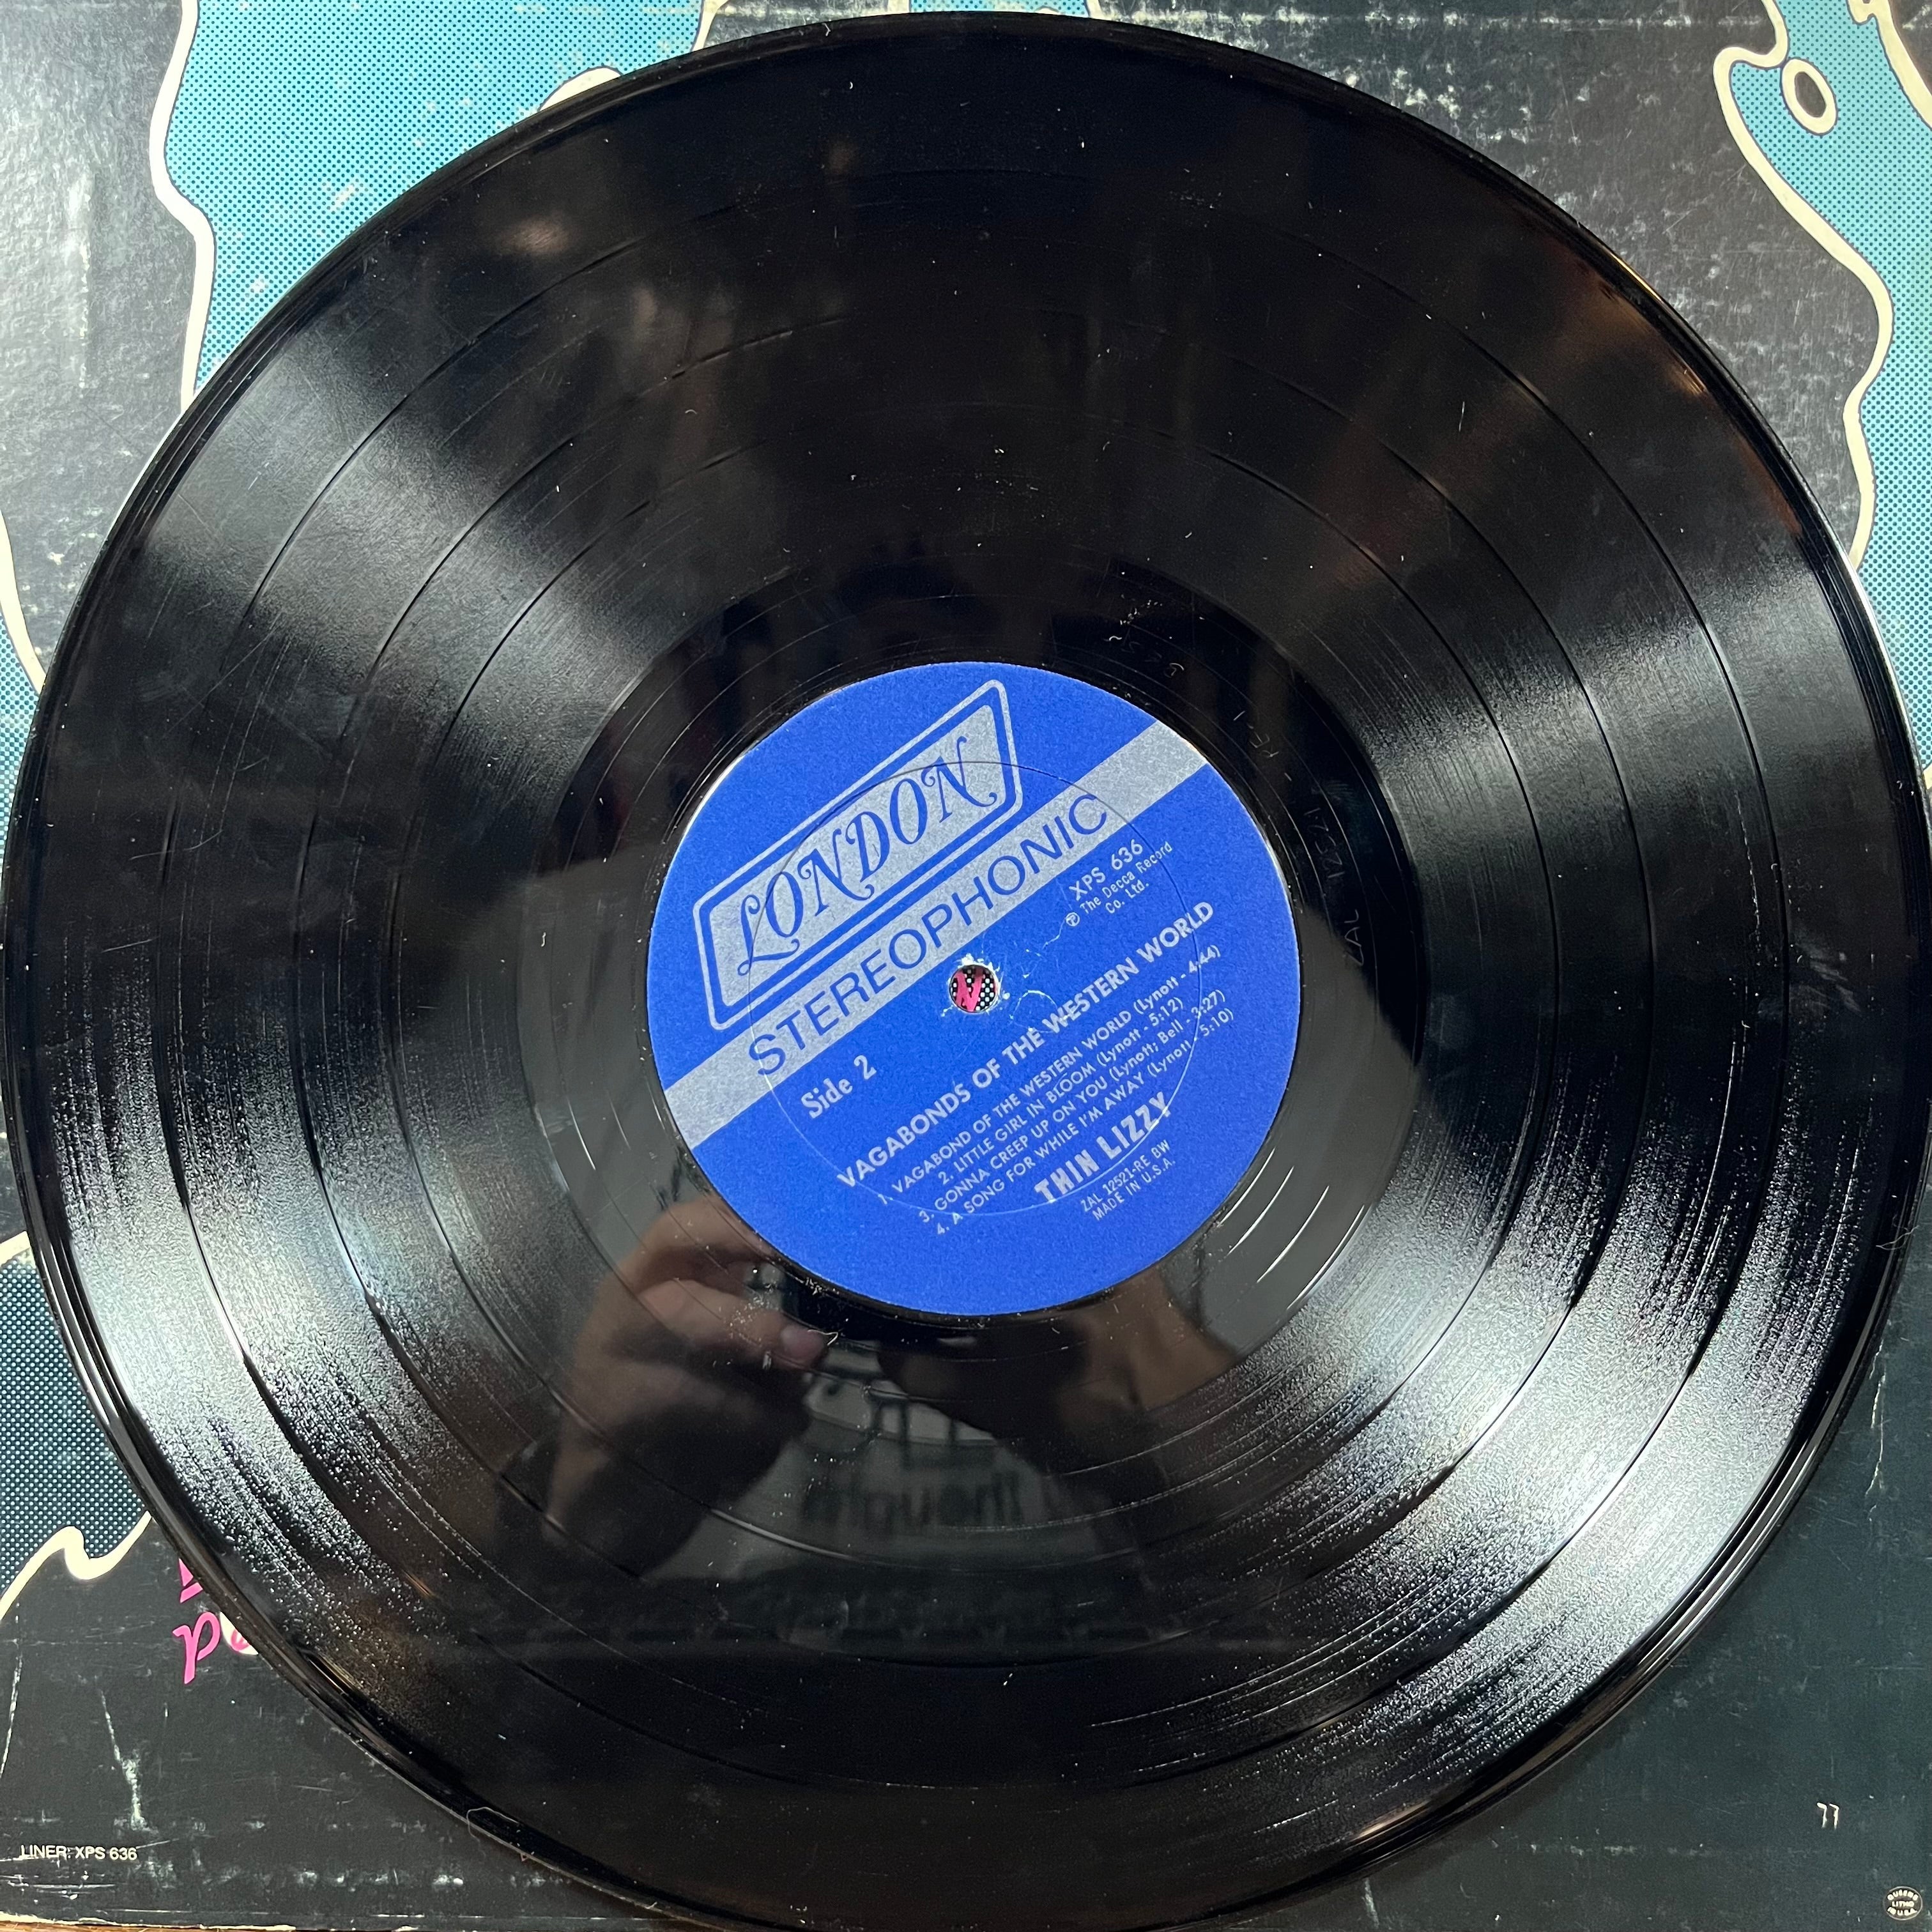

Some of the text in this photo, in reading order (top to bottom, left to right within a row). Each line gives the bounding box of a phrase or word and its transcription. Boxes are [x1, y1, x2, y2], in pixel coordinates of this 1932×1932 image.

[737, 736, 997, 976] LONDON
[1069, 839, 1143, 900] XPS 636
[1080, 897, 1101, 914] The
[1102, 871, 1135, 898] Decca
[1135, 841, 1173, 873] Record
[1105, 880, 1149, 914] Co. Ltd.
[748, 794, 1107, 1075] STEREOPHONIC
[801, 1055, 877, 1119] Side 2
[837, 901, 1214, 1187] VAGABONDS OF THE WESTERN WORLD
[892, 1130, 972, 1193] VAGABOND
[972, 1114, 992, 1134] OF
[992, 1093, 1021, 1118] THE
[1019, 1046, 1084, 1097] WESTERN
[1081, 1010, 1131, 1050] WORLD
[1133, 976, 1179, 1015] (Lynott
[938, 1170, 954, 1185] 2.
[953, 1137, 995, 1172] LITTLE
[995, 1114, 1027, 1141] GIRL
[1026, 1098, 1046, 1118] IN
[1045, 1062, 1096, 1103] BLOOM
[1096, 1027, 1141, 1067] (Lynott
[1149, 997, 1184, 1027] 5:12)
[919, 1209, 935, 1223] 3.
[934, 1168, 990, 1211] GONNA
[990, 1135, 1029, 1169] CREEP
[1030, 1119, 1049, 1138] UP
[1052, 1100, 1077, 1123] ON
[1076, 1075, 1108, 1104] YOU
[1157, 1018, 1184, 1045] Bell
[1191, 989, 1226, 1018] 3:27)
[937, 1222, 950, 1235] 4.
[952, 1212, 963, 1225] A
[963, 1178, 1006, 1214] SONG
[1006, 1156, 1036, 1183] FOR
[1034, 1123, 1080, 1158] WHILE
[1078, 1106, 1103, 1128] I'M
[1103, 1071, 1144, 1110] AWAY
[1146, 1039, 1192, 1078] (Lynott
[1199, 1008, 1234, 1037] 5:10)
[1034, 1091, 1172, 1203] THIN LIZZY
[1080, 1139, 1171, 1212] ZAL 12521-RE BW
[1092, 1157, 1176, 1221] MADE IN U.S.A.
[20, 1844, 138, 1860] LINER: XPS 636
